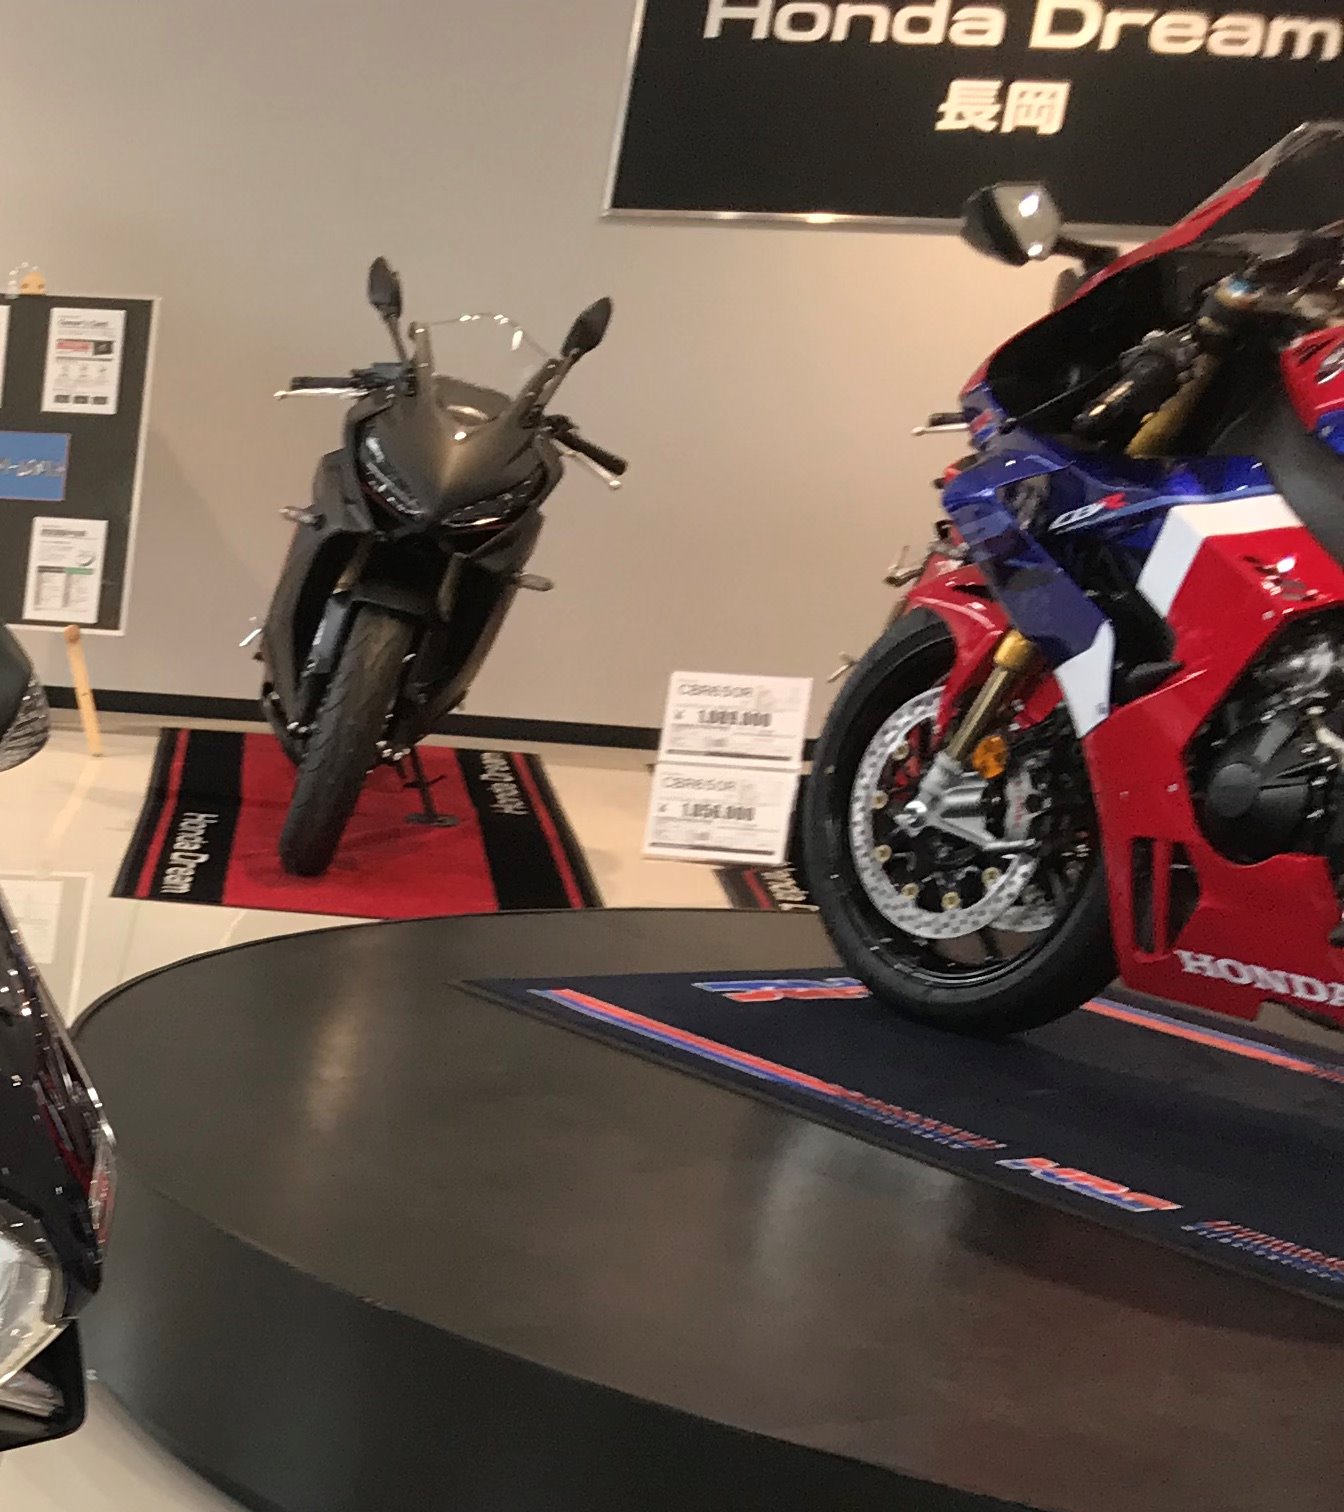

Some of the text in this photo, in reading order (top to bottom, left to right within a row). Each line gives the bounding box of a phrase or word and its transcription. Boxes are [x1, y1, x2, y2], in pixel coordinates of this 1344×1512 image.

[703, 0, 1343, 61] Honda Dream
[935, 79, 1072, 135] 長岡
[160, 812, 219, 893] Honda Dream
